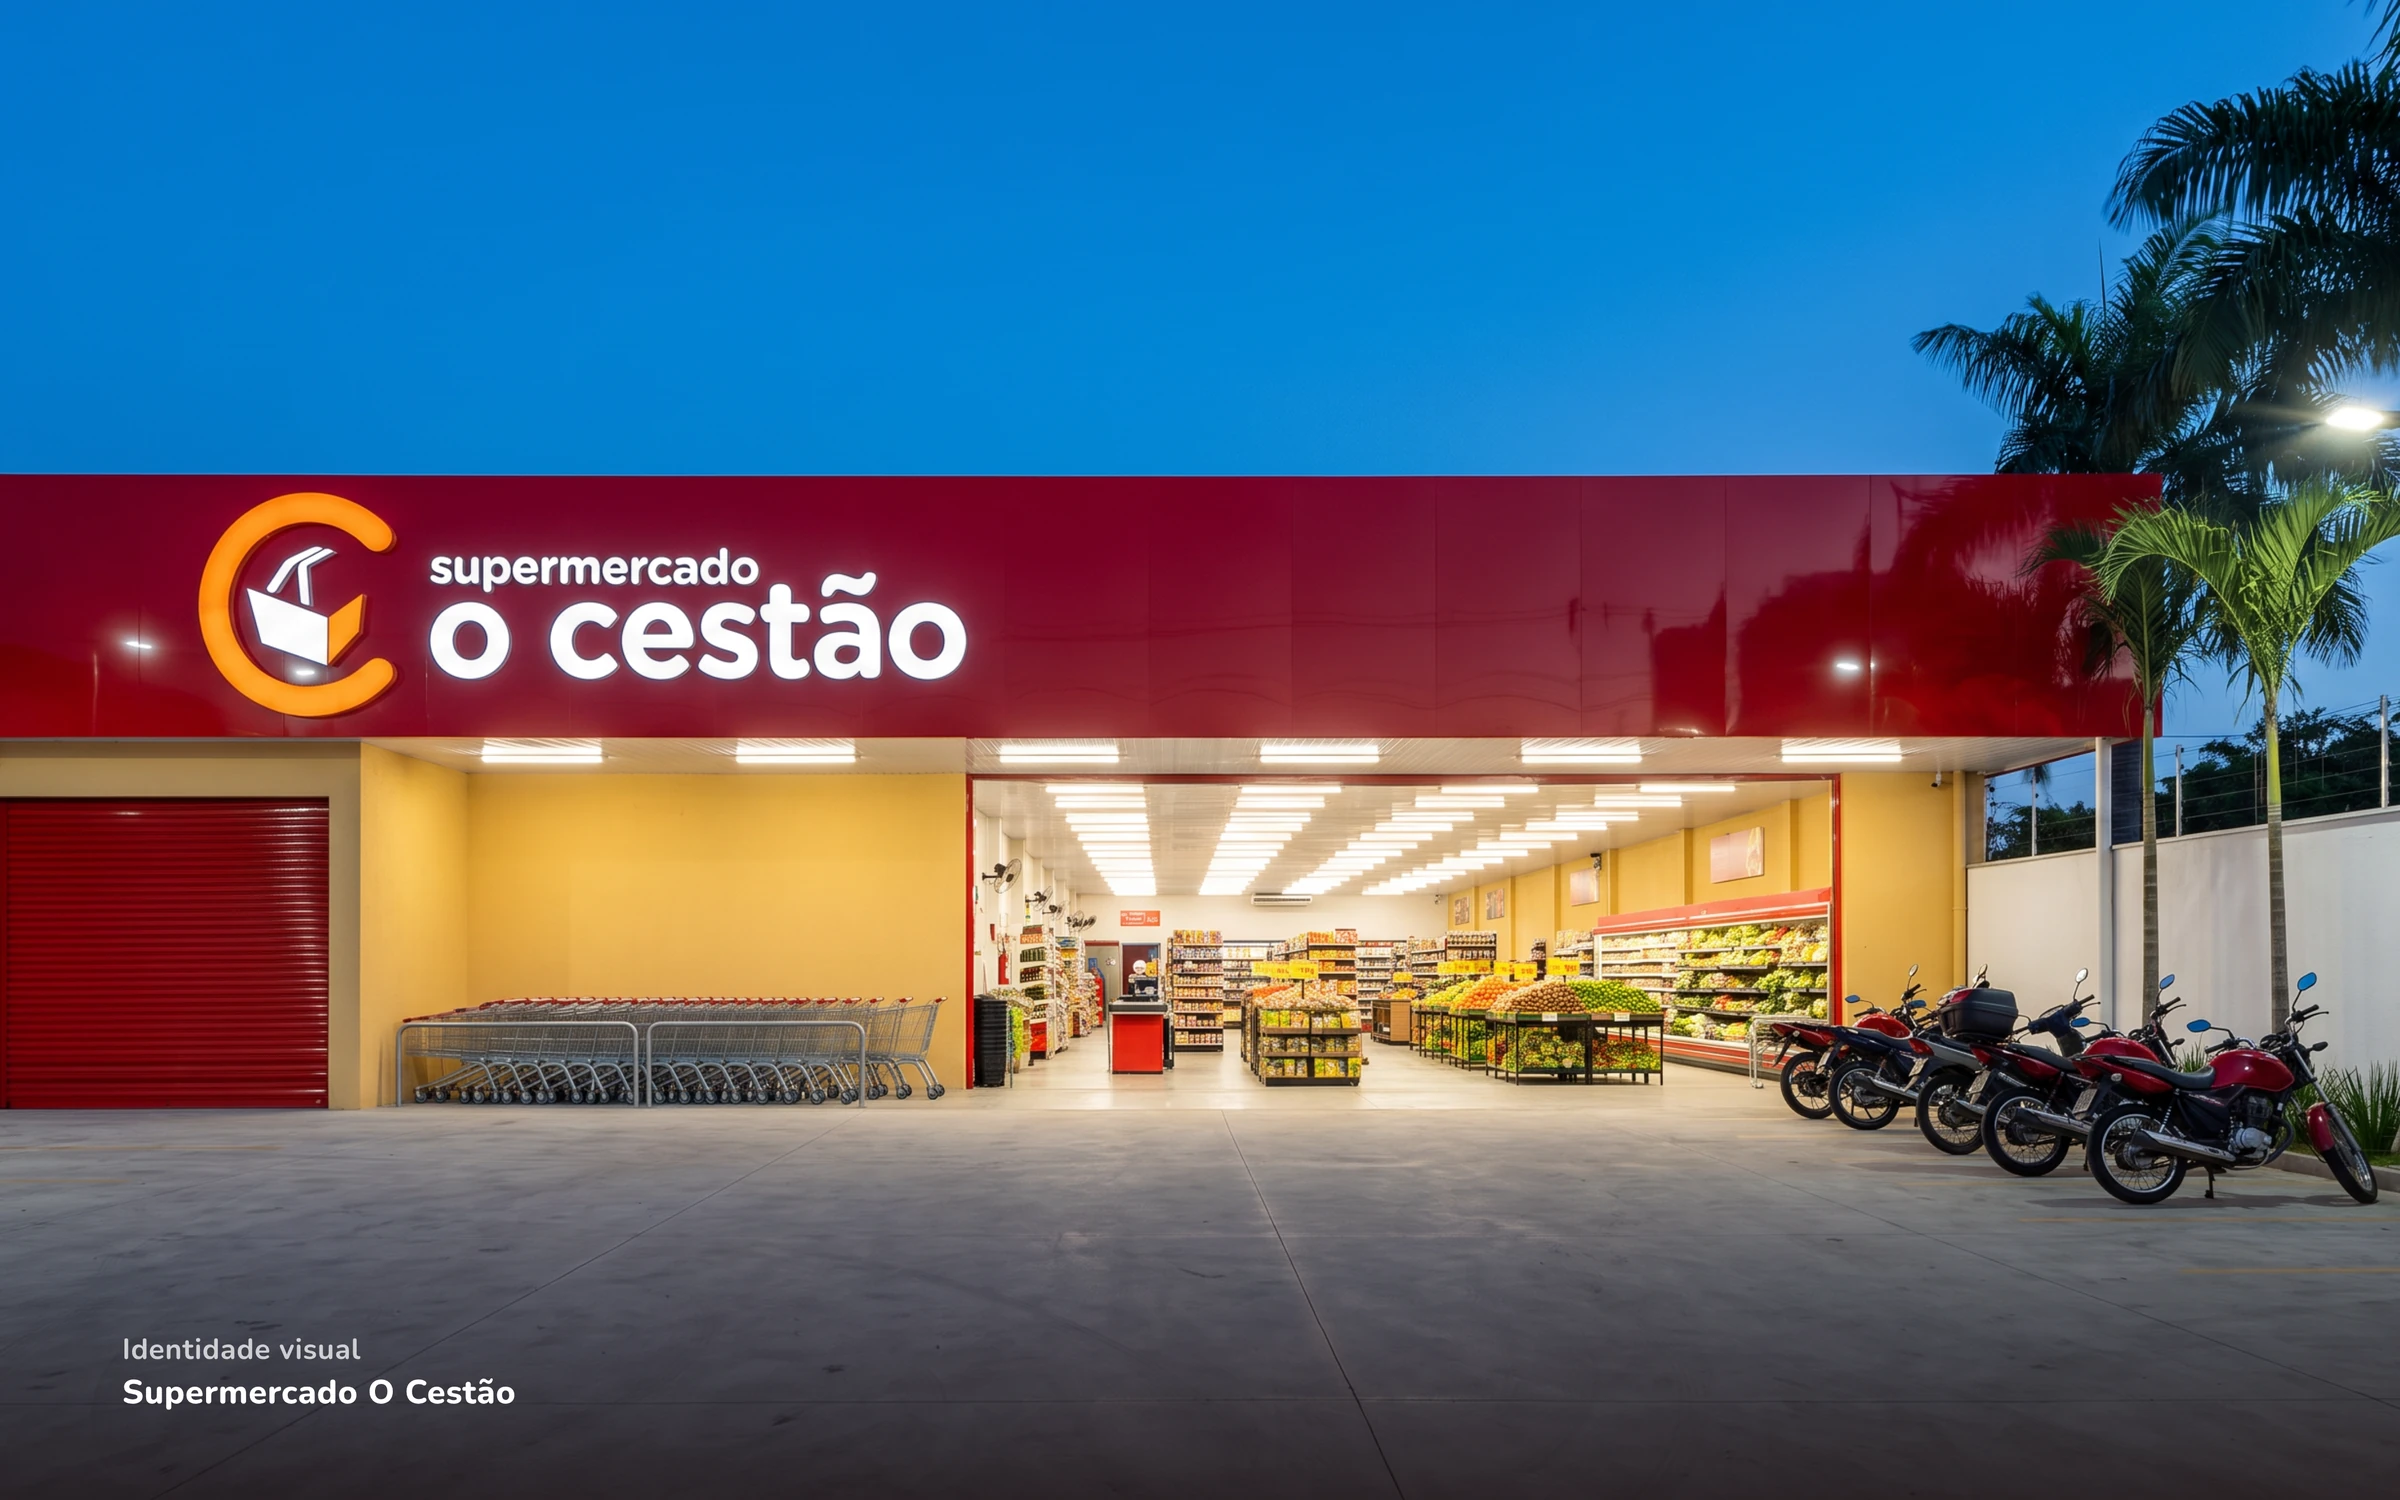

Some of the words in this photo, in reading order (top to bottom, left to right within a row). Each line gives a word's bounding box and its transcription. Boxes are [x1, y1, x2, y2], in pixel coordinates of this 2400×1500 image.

[429, 547, 760, 594] supermercado
[428, 600, 511, 681] o
[549, 571, 968, 681] cestão
